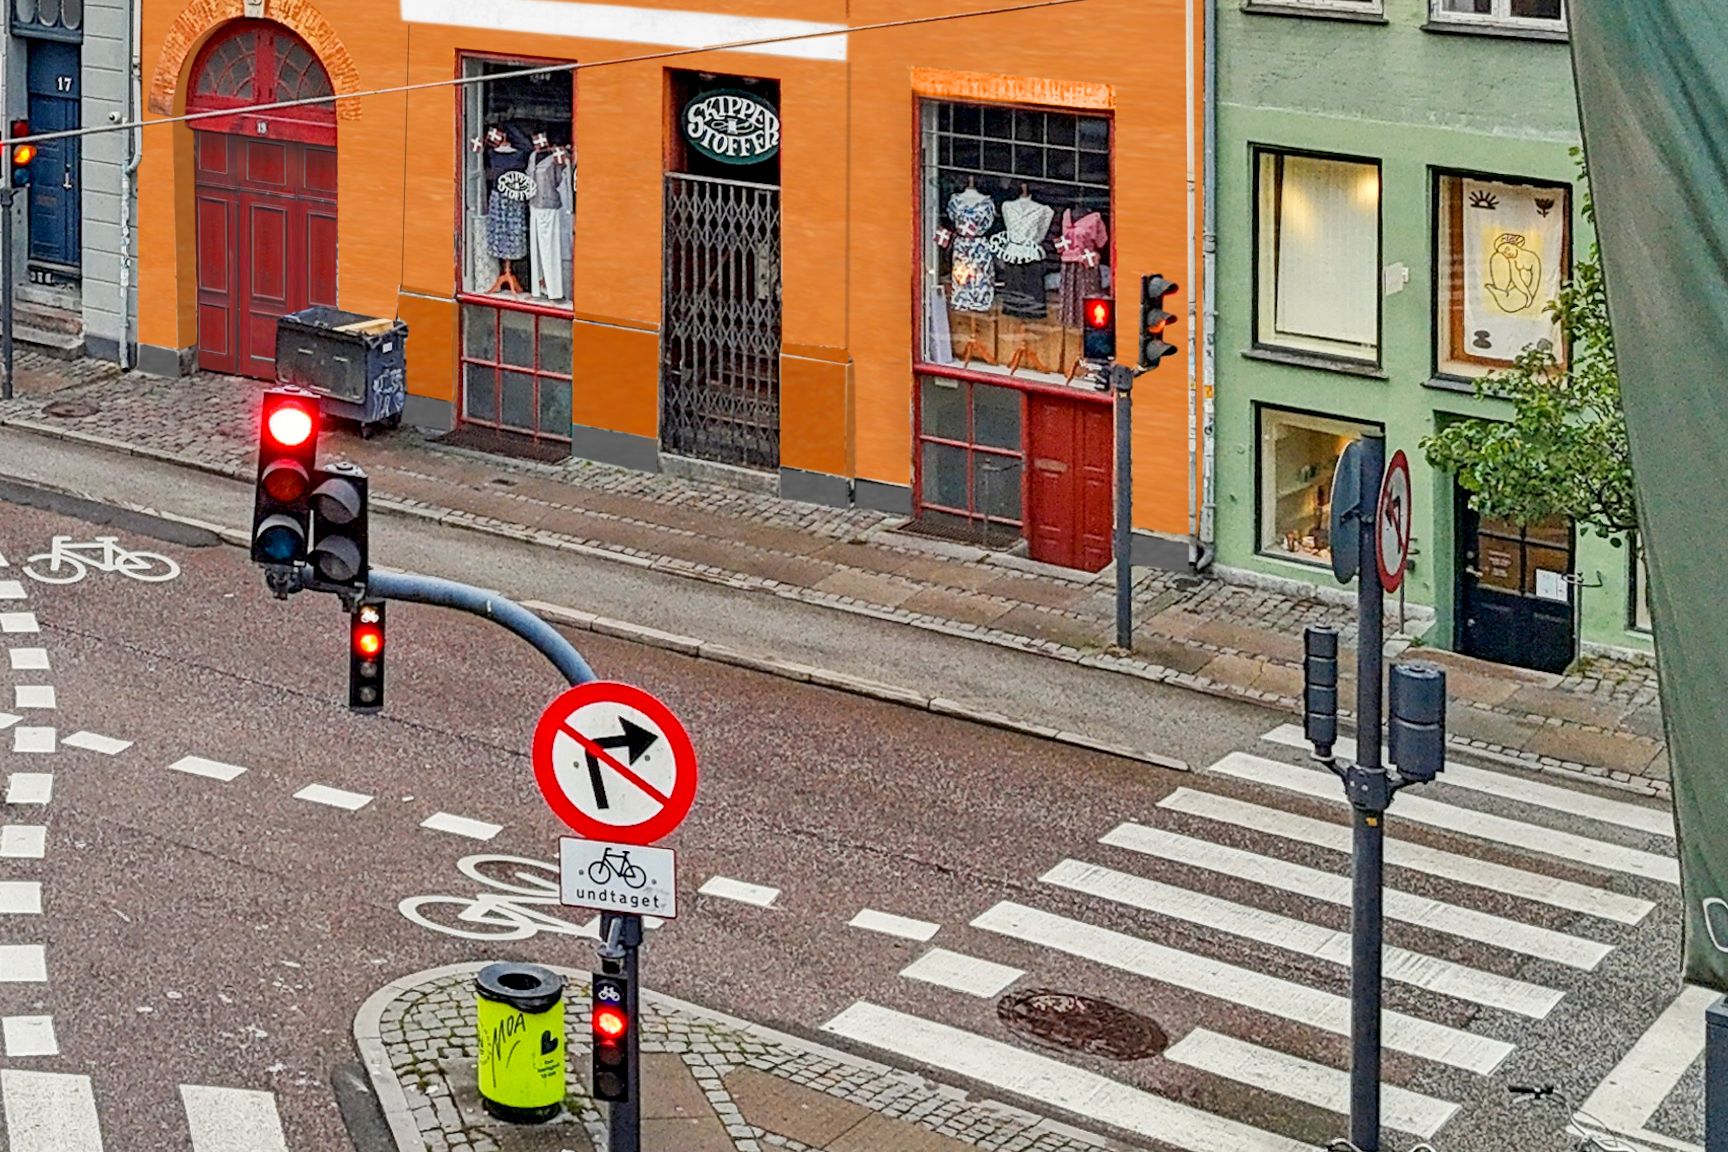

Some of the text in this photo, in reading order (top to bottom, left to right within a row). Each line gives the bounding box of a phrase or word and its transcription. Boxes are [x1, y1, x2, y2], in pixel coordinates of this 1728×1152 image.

[57, 76, 72, 92] 17
[687, 95, 780, 142] SKIPPER
[687, 109, 780, 157] STOFFER
[576, 888, 660, 909] undtaget
